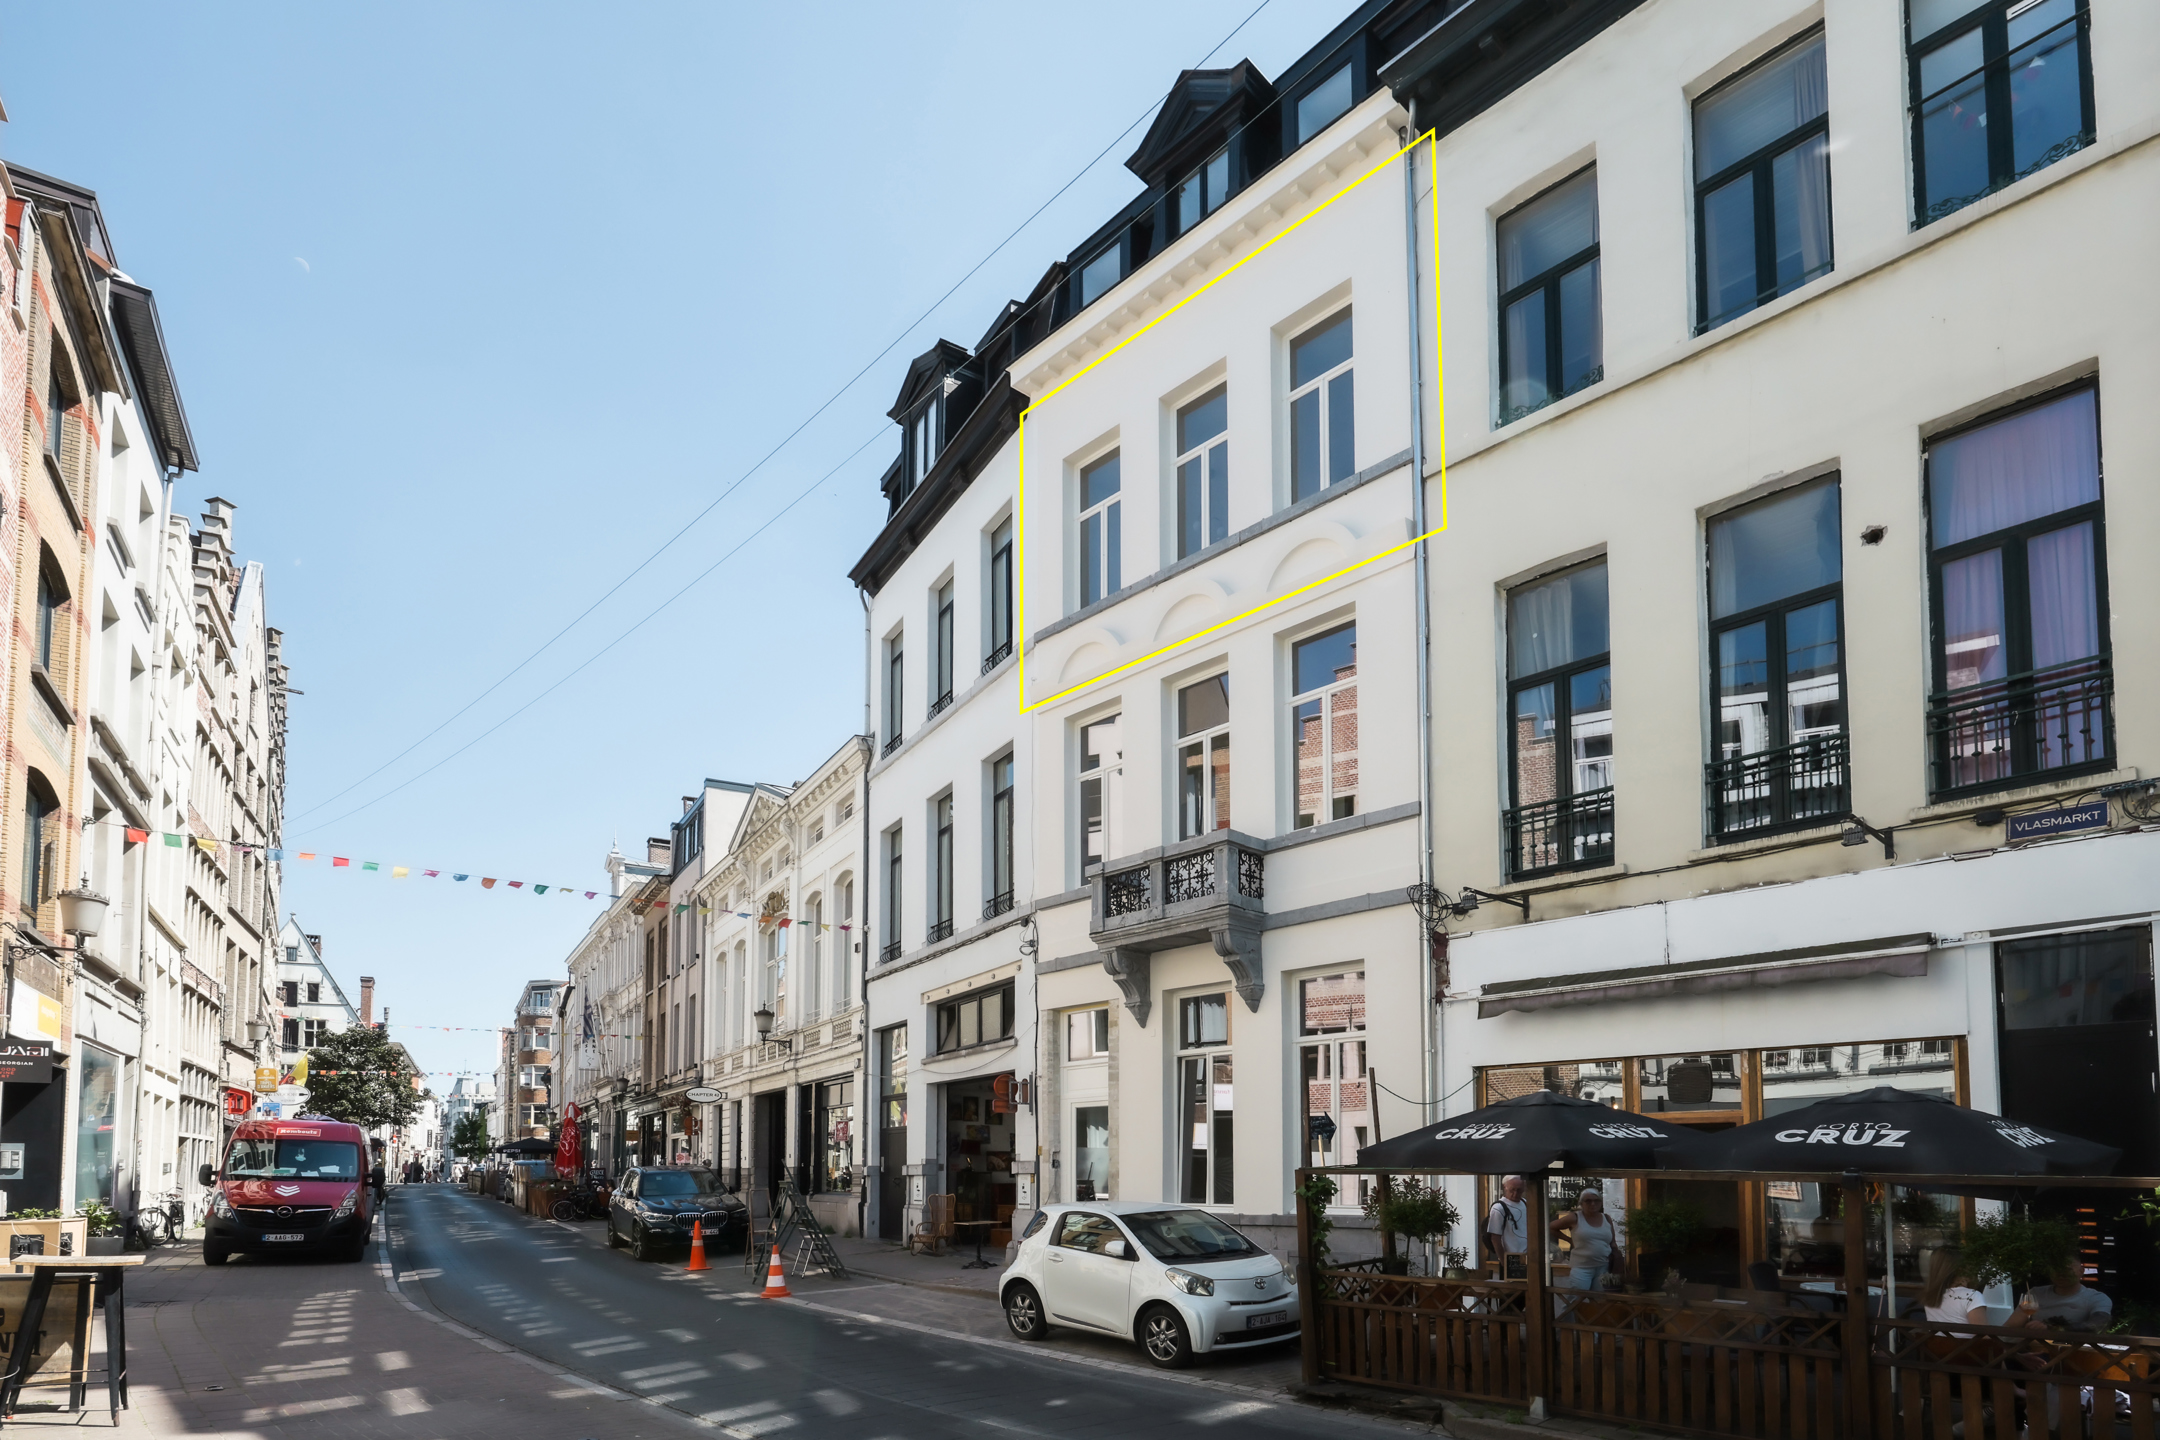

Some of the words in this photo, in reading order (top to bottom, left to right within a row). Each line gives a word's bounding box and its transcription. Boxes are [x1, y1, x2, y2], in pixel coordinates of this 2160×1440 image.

[2015, 810, 2101, 832] VLASMARKT
[1435, 1128, 1517, 1140] CRUZ
[1588, 1127, 1668, 1138] CRUZ
[1815, 1122, 1892, 1131] PORTO
[1774, 1129, 1912, 1148] CRUZ
[1995, 1127, 2056, 1148] CRUZ
